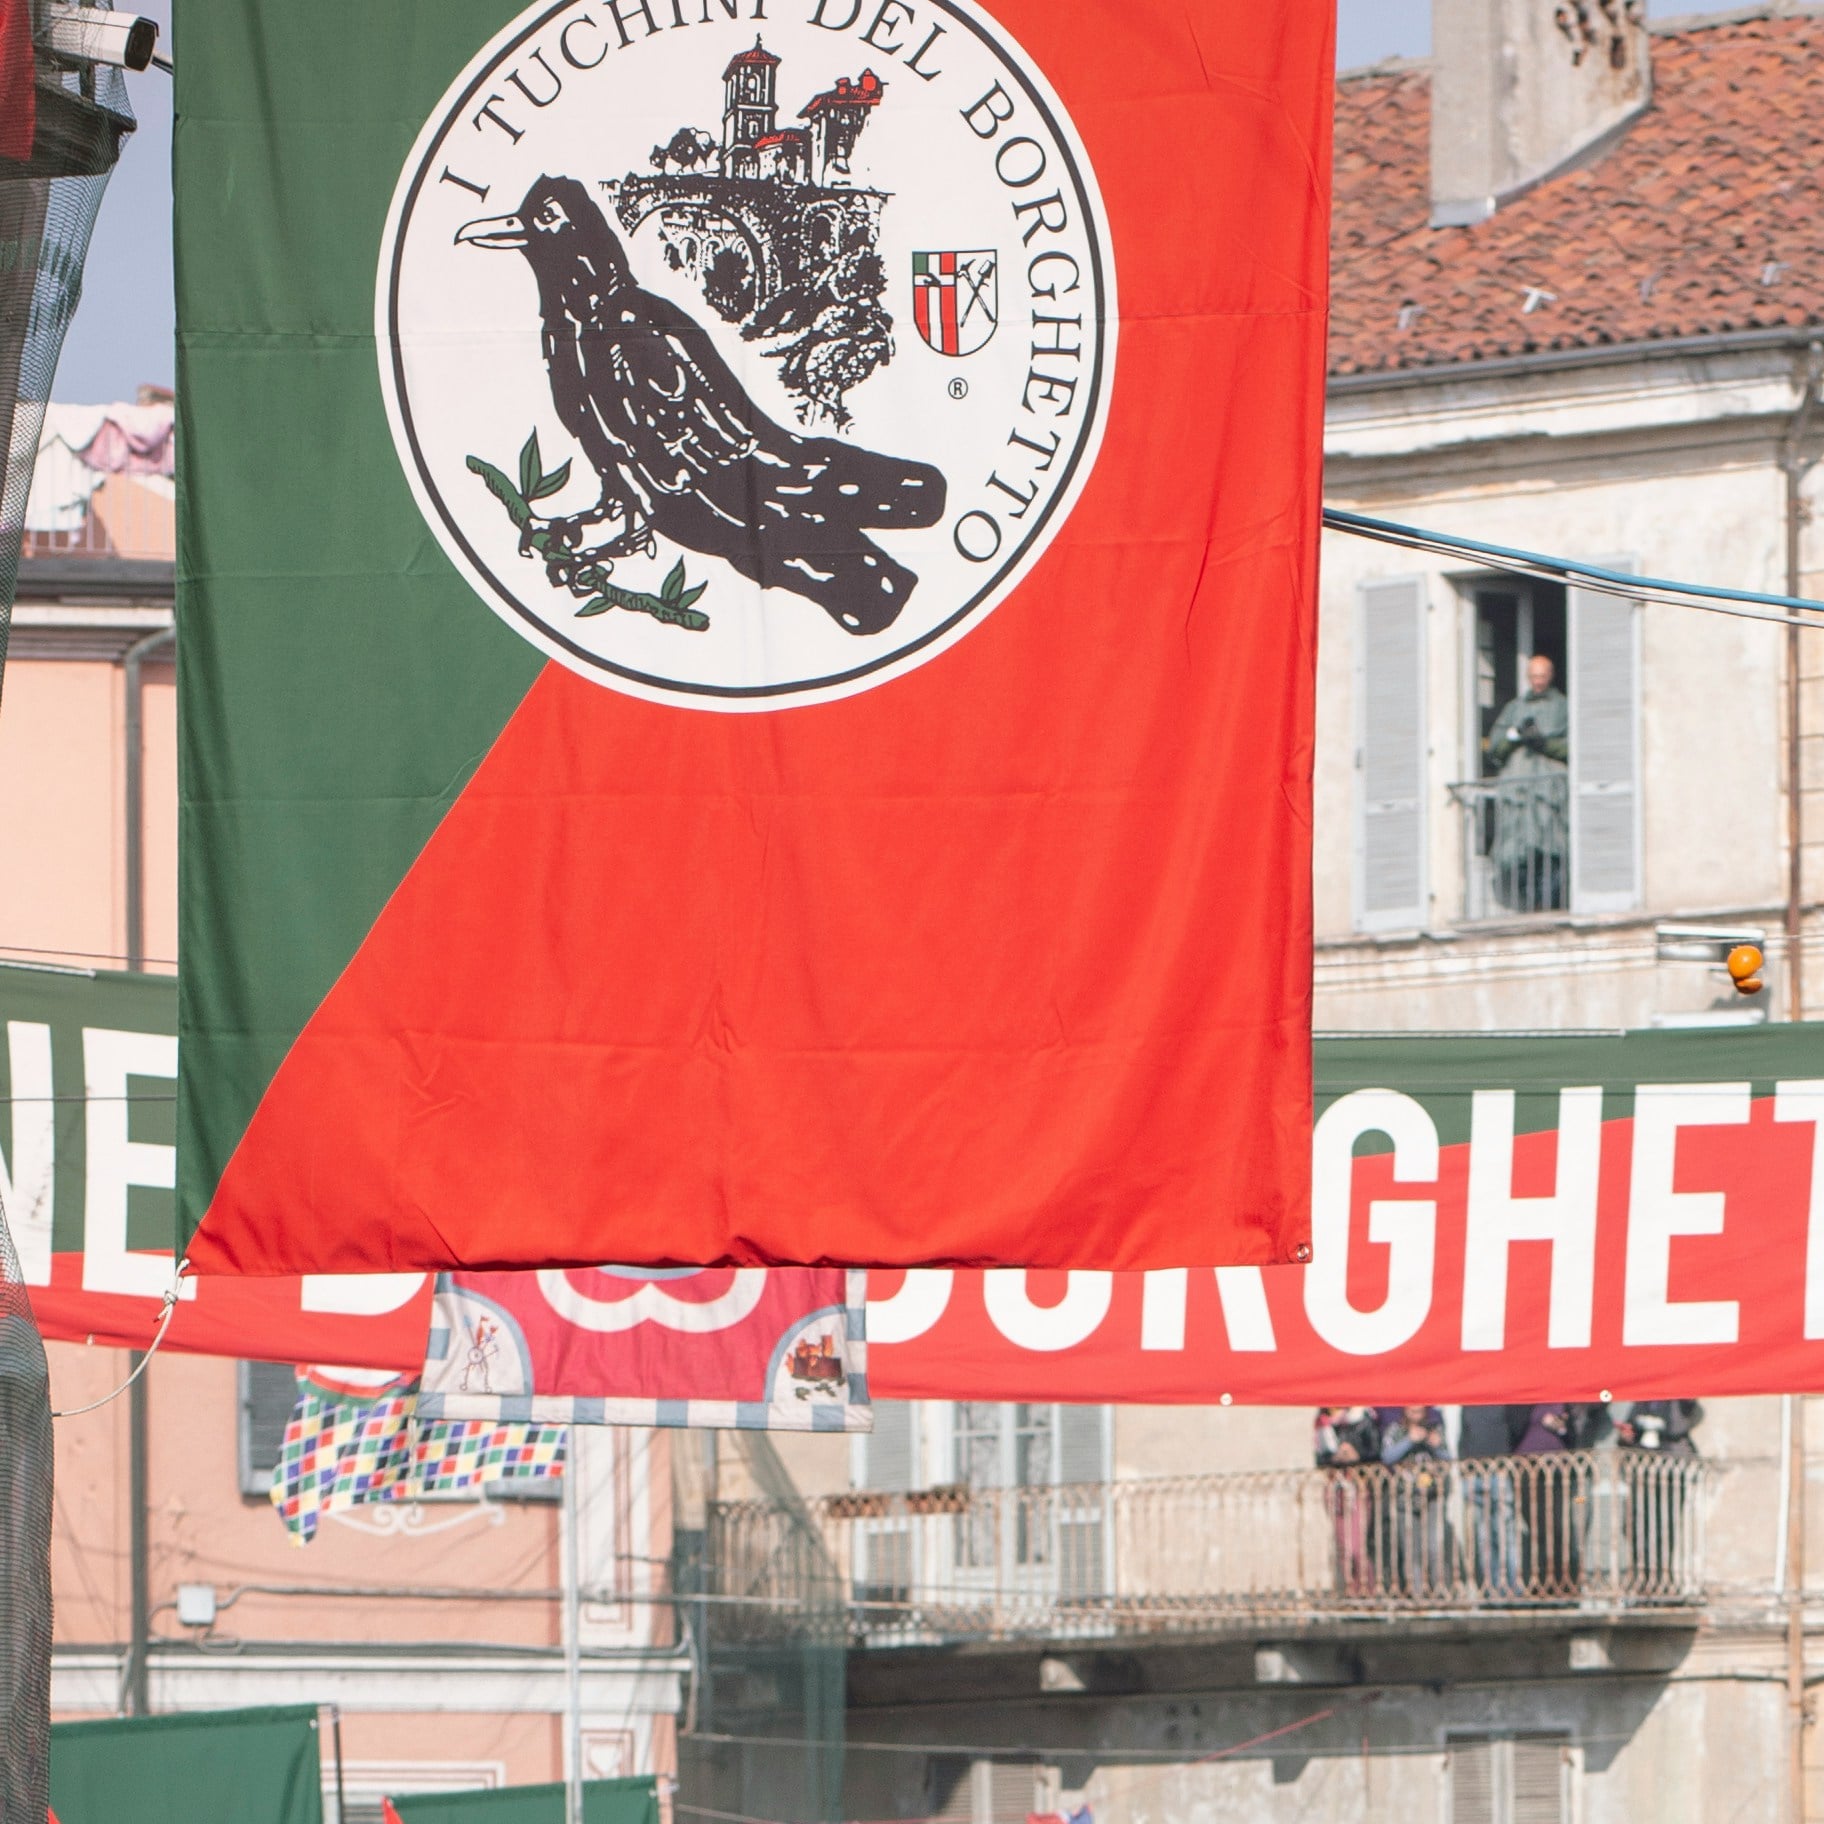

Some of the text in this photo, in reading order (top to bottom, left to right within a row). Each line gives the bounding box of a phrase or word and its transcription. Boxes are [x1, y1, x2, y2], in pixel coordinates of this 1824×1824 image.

[439, 165, 491, 204] I
[806, 0, 944, 82] DEL
[952, 78, 1083, 563] BORGHETTO
